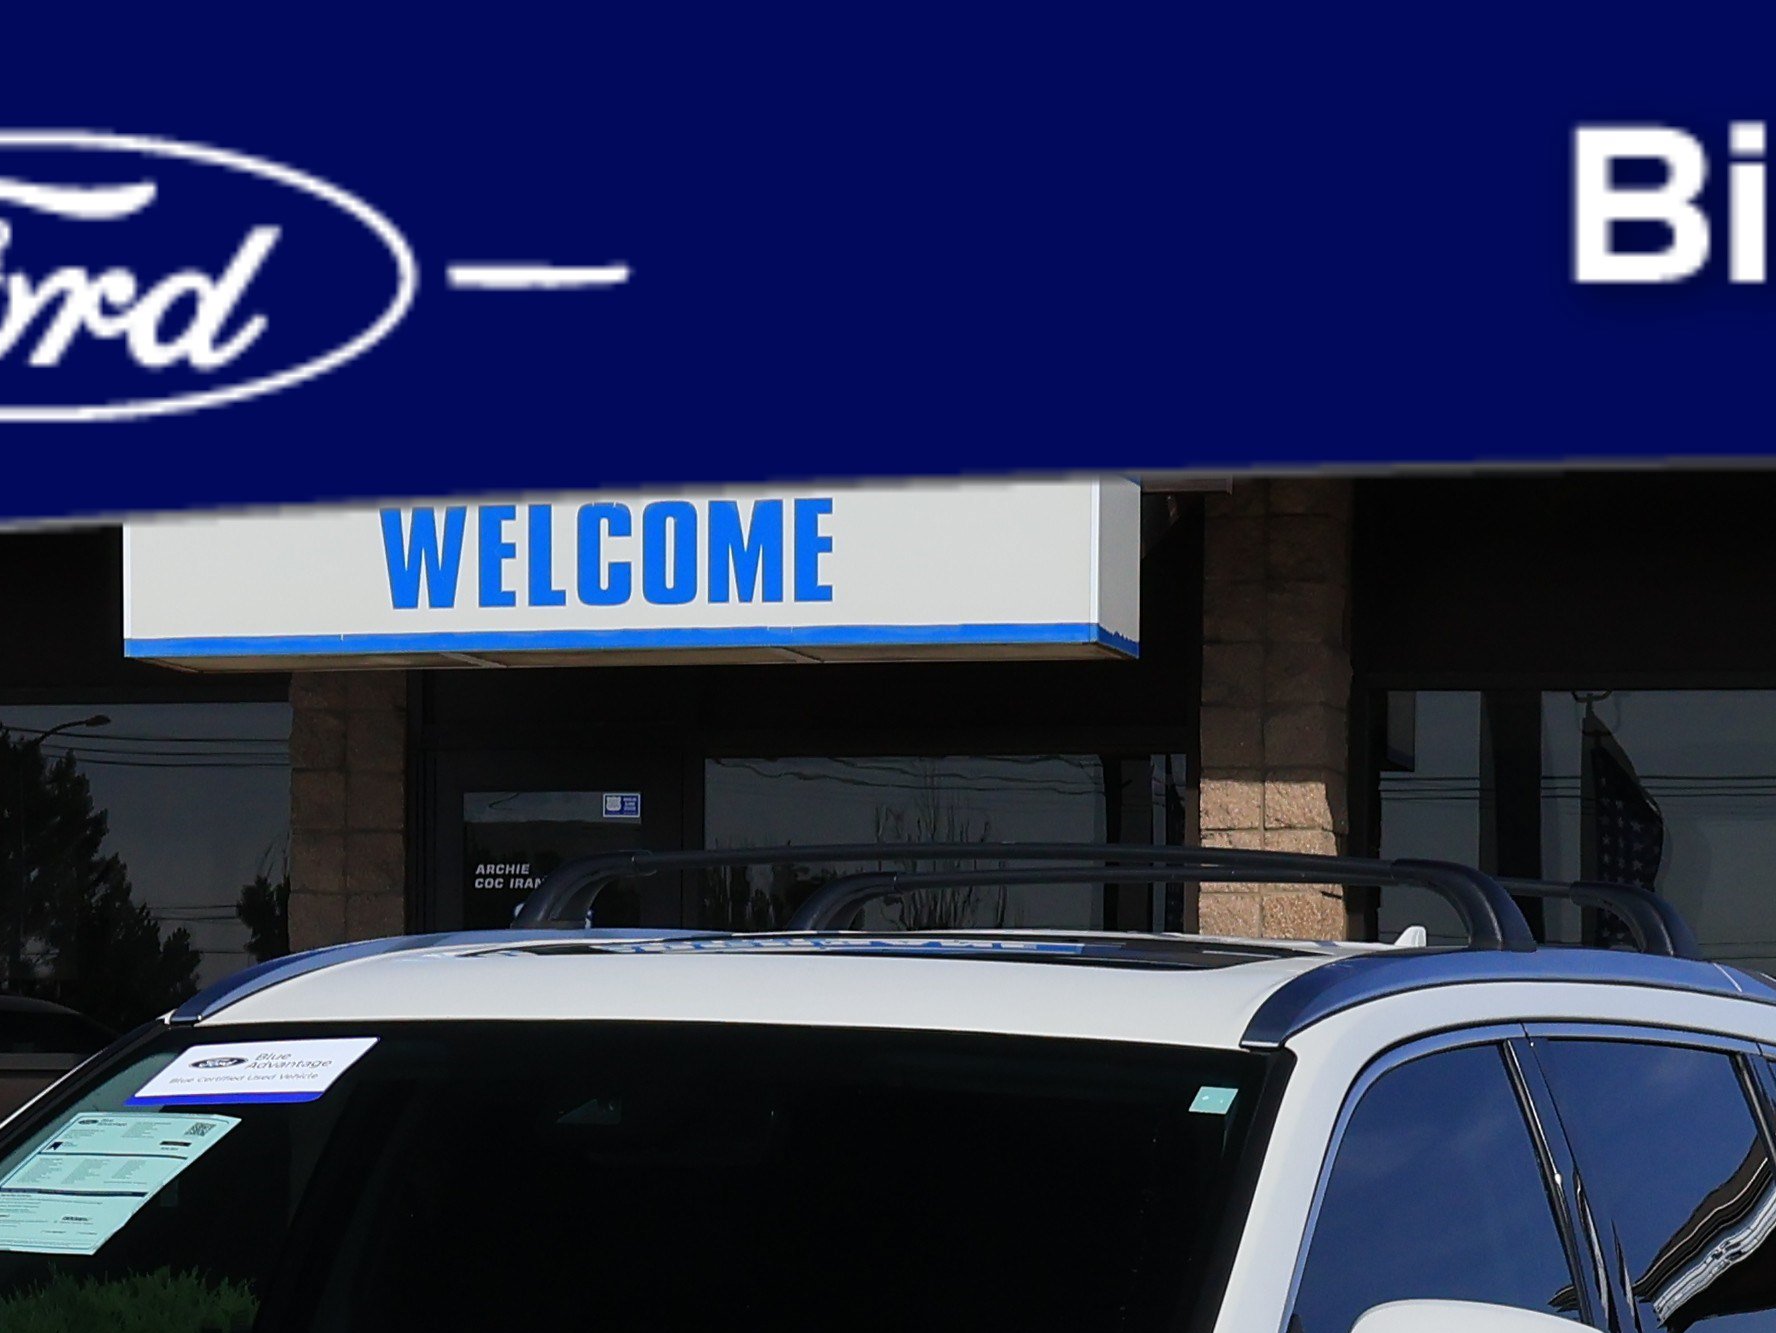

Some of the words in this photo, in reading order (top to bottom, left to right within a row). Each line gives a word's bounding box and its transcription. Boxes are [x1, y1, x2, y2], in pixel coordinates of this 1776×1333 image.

[378, 497, 833, 610] WELCOME
[475, 863, 530, 875] ARCHIE
[255, 1053, 291, 1061] Blue
[245, 1059, 332, 1069] Advantage
